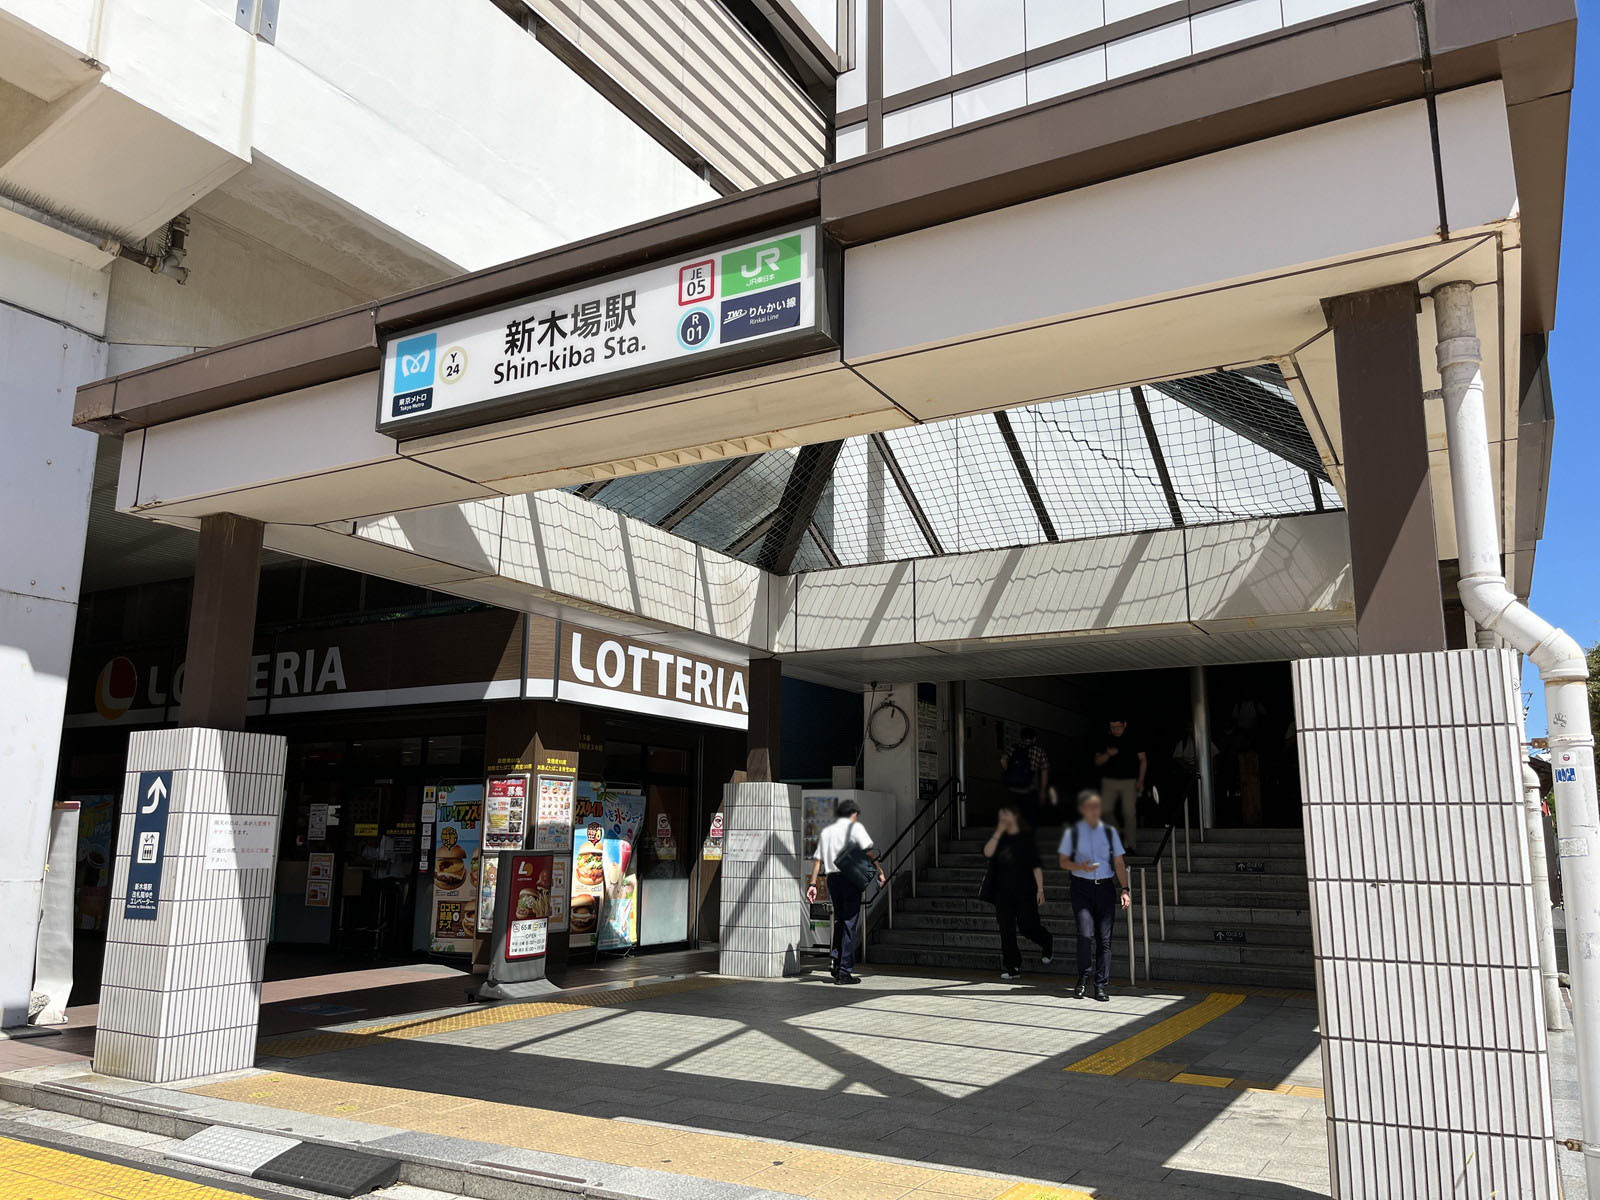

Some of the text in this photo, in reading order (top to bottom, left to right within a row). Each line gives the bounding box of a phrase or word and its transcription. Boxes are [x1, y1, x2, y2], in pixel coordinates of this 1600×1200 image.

[741, 247, 780, 278] JR
[690, 268, 703, 281] JE
[746, 274, 776, 287] JR東日本
[687, 279, 706, 297] 05
[749, 296, 797, 318] りんかい線
[504, 290, 637, 356] 新木場駅
[691, 314, 699, 325] R
[749, 313, 779, 326] Rinkai Line
[686, 325, 702, 342] 01
[450, 352, 458, 363] Y
[493, 335, 646, 384] Shin-kiba Sta.
[446, 364, 460, 377] 24
[399, 393, 427, 407] 東京メトロ
[571, 631, 749, 713] LOTTERIA
